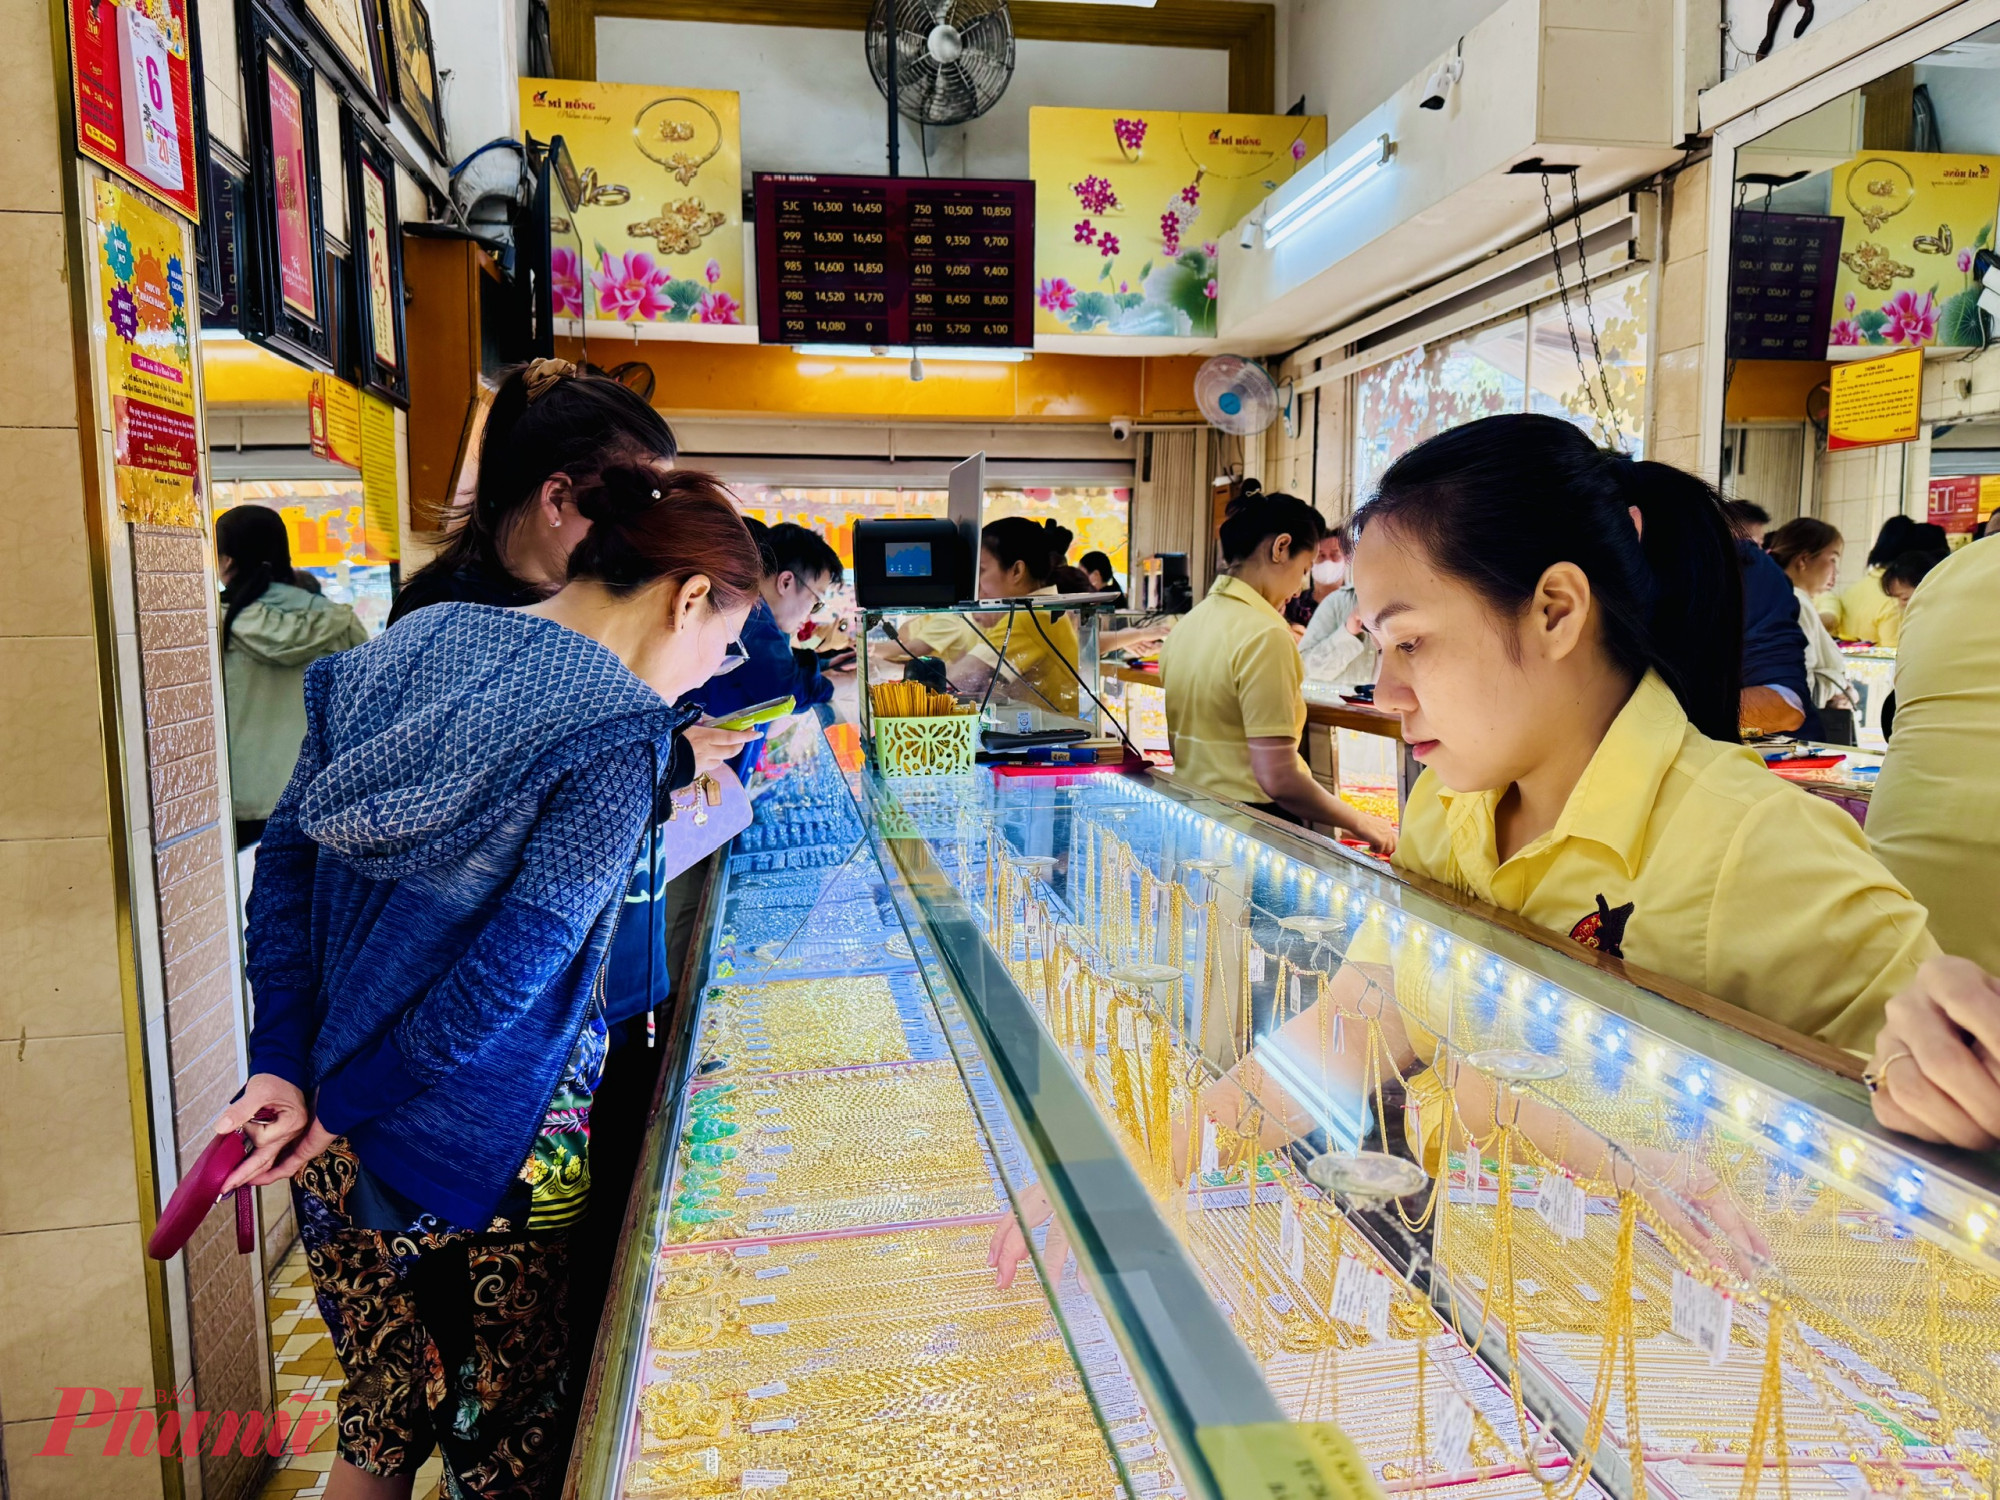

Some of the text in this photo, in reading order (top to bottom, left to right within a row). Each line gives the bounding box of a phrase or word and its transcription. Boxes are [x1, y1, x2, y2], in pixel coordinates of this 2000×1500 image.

[145, 55, 163, 111] 6
[782, 200, 883, 214] SJC 16,300 16,450
[914, 204, 1012, 218] 750 10,500 10,850
[783, 231, 883, 244] 999 16,300 16,450
[914, 234, 1009, 248] 680 9,350 9,700
[784, 260, 884, 274] 985 14,600 14,850
[914, 264, 1009, 277] 610 9,050 9,400
[785, 290, 884, 304] 980 14,520 14,770
[915, 294, 1008, 306] 580 8,450 8,800
[786, 320, 873, 332] 950 14,080 0
[915, 323, 1008, 335] 410 5,750 6,100
